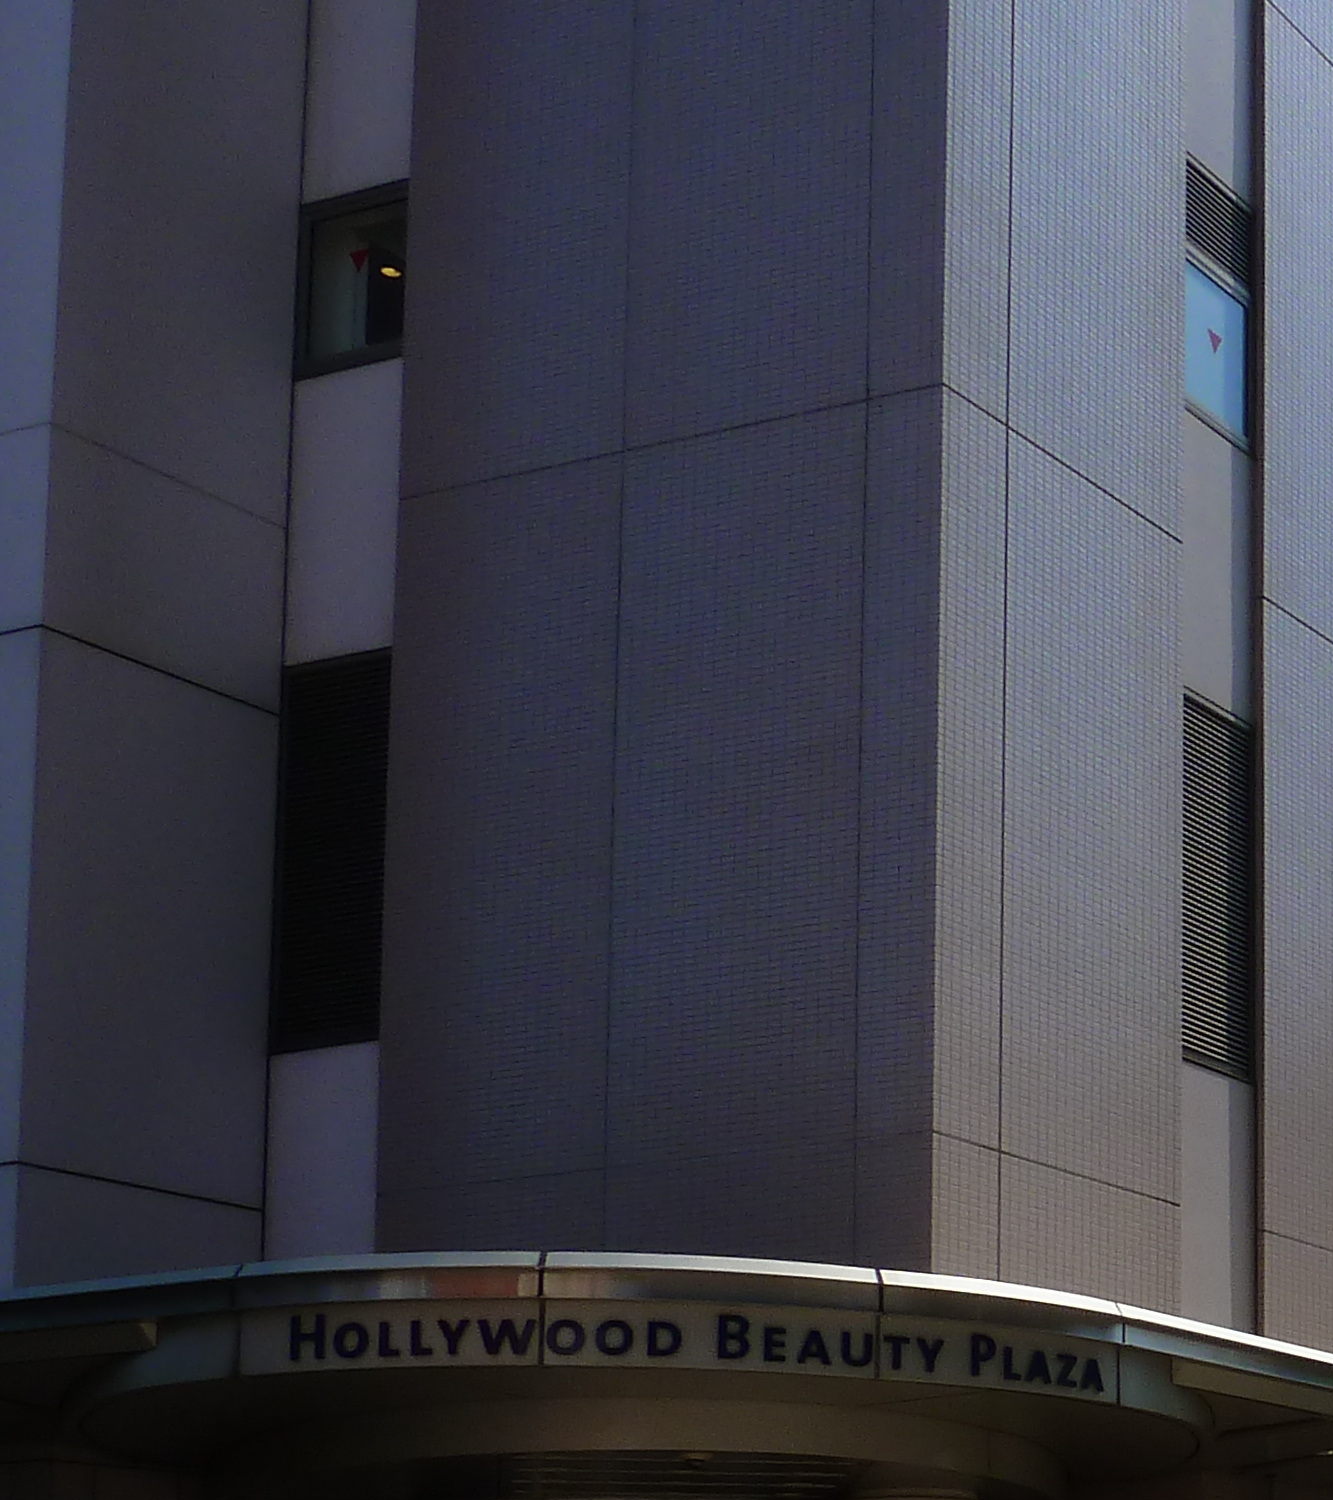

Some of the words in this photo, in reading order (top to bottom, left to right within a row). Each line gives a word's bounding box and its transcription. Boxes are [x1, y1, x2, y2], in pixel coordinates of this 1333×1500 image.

[289, 1315, 682, 1361] HOLLYWOOD
[716, 1314, 944, 1370] BEAUTY
[971, 1333, 1105, 1392] PLAZA
